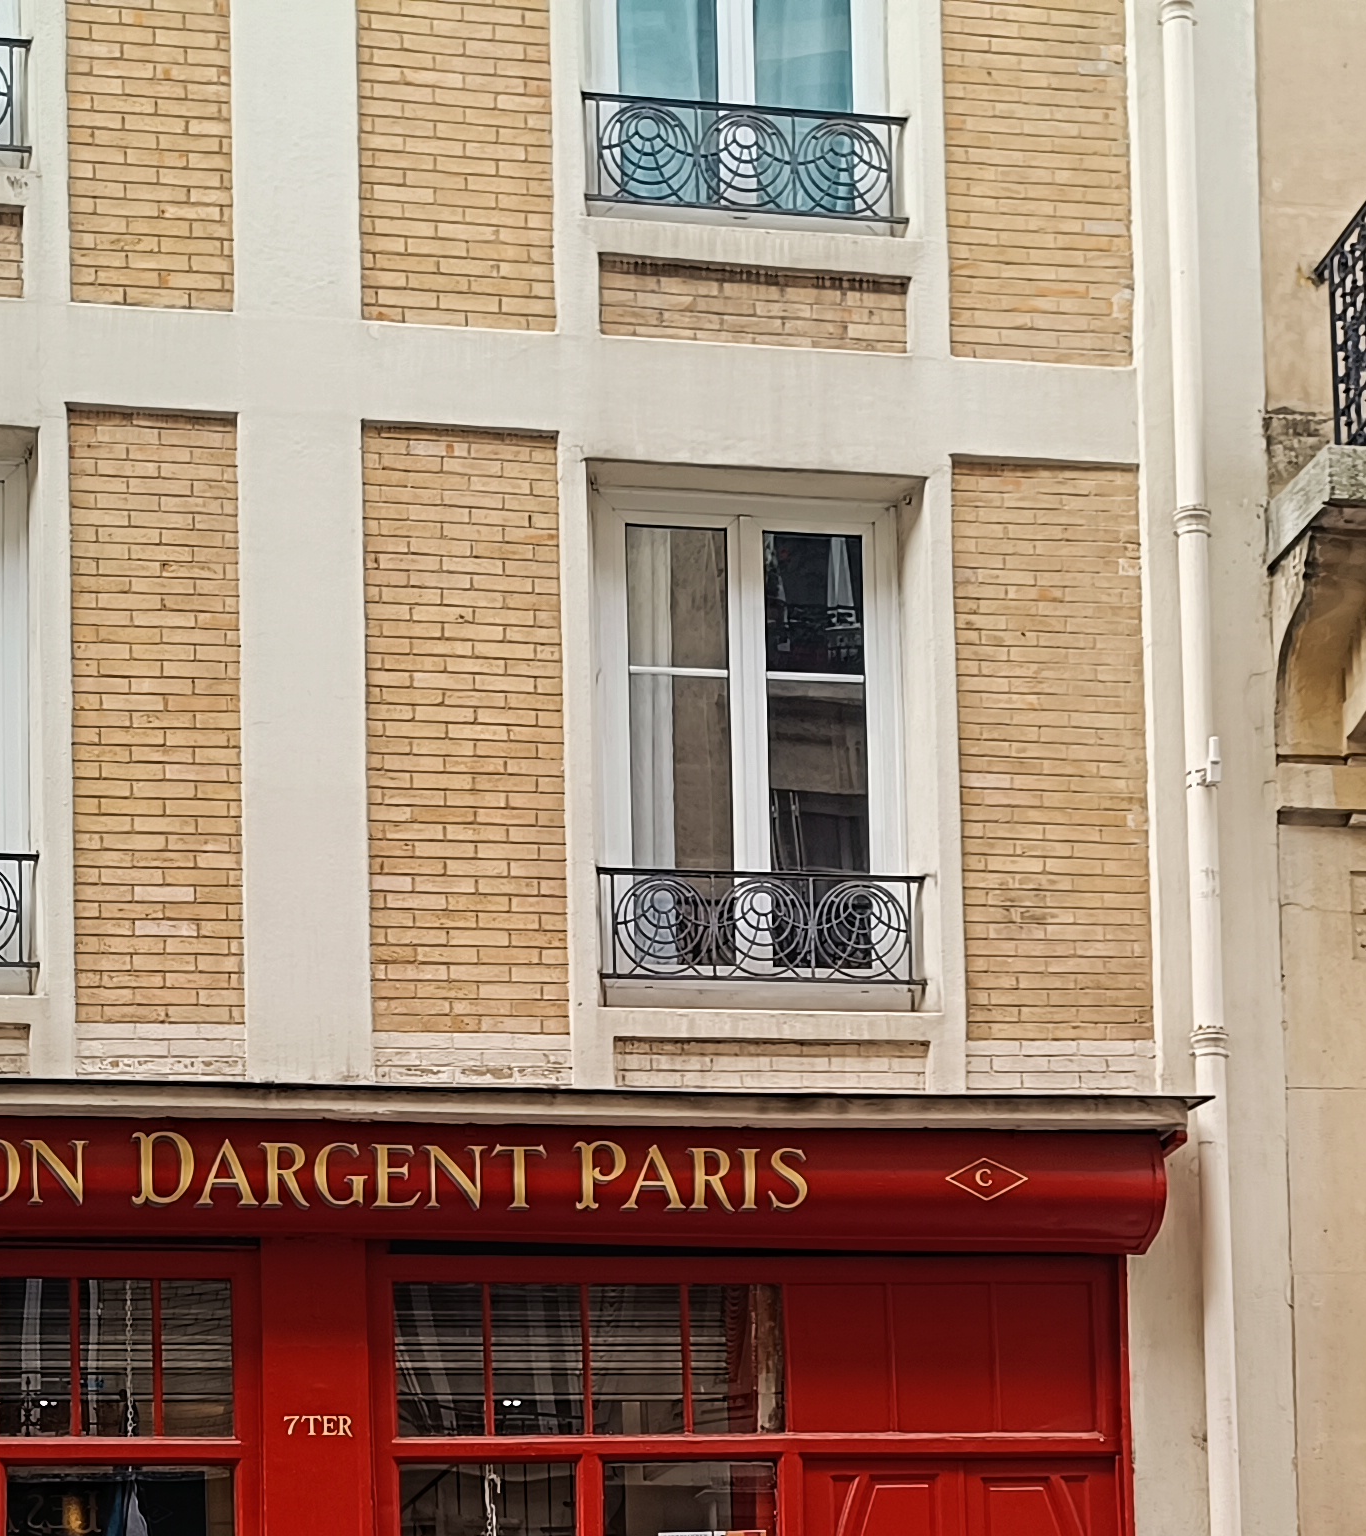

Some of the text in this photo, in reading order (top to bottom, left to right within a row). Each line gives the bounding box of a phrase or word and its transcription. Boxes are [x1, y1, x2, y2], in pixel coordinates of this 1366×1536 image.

[130, 1130, 547, 1212] DARGENT
[572, 1140, 809, 1213] PARIS
[975, 1168, 993, 1187] C
